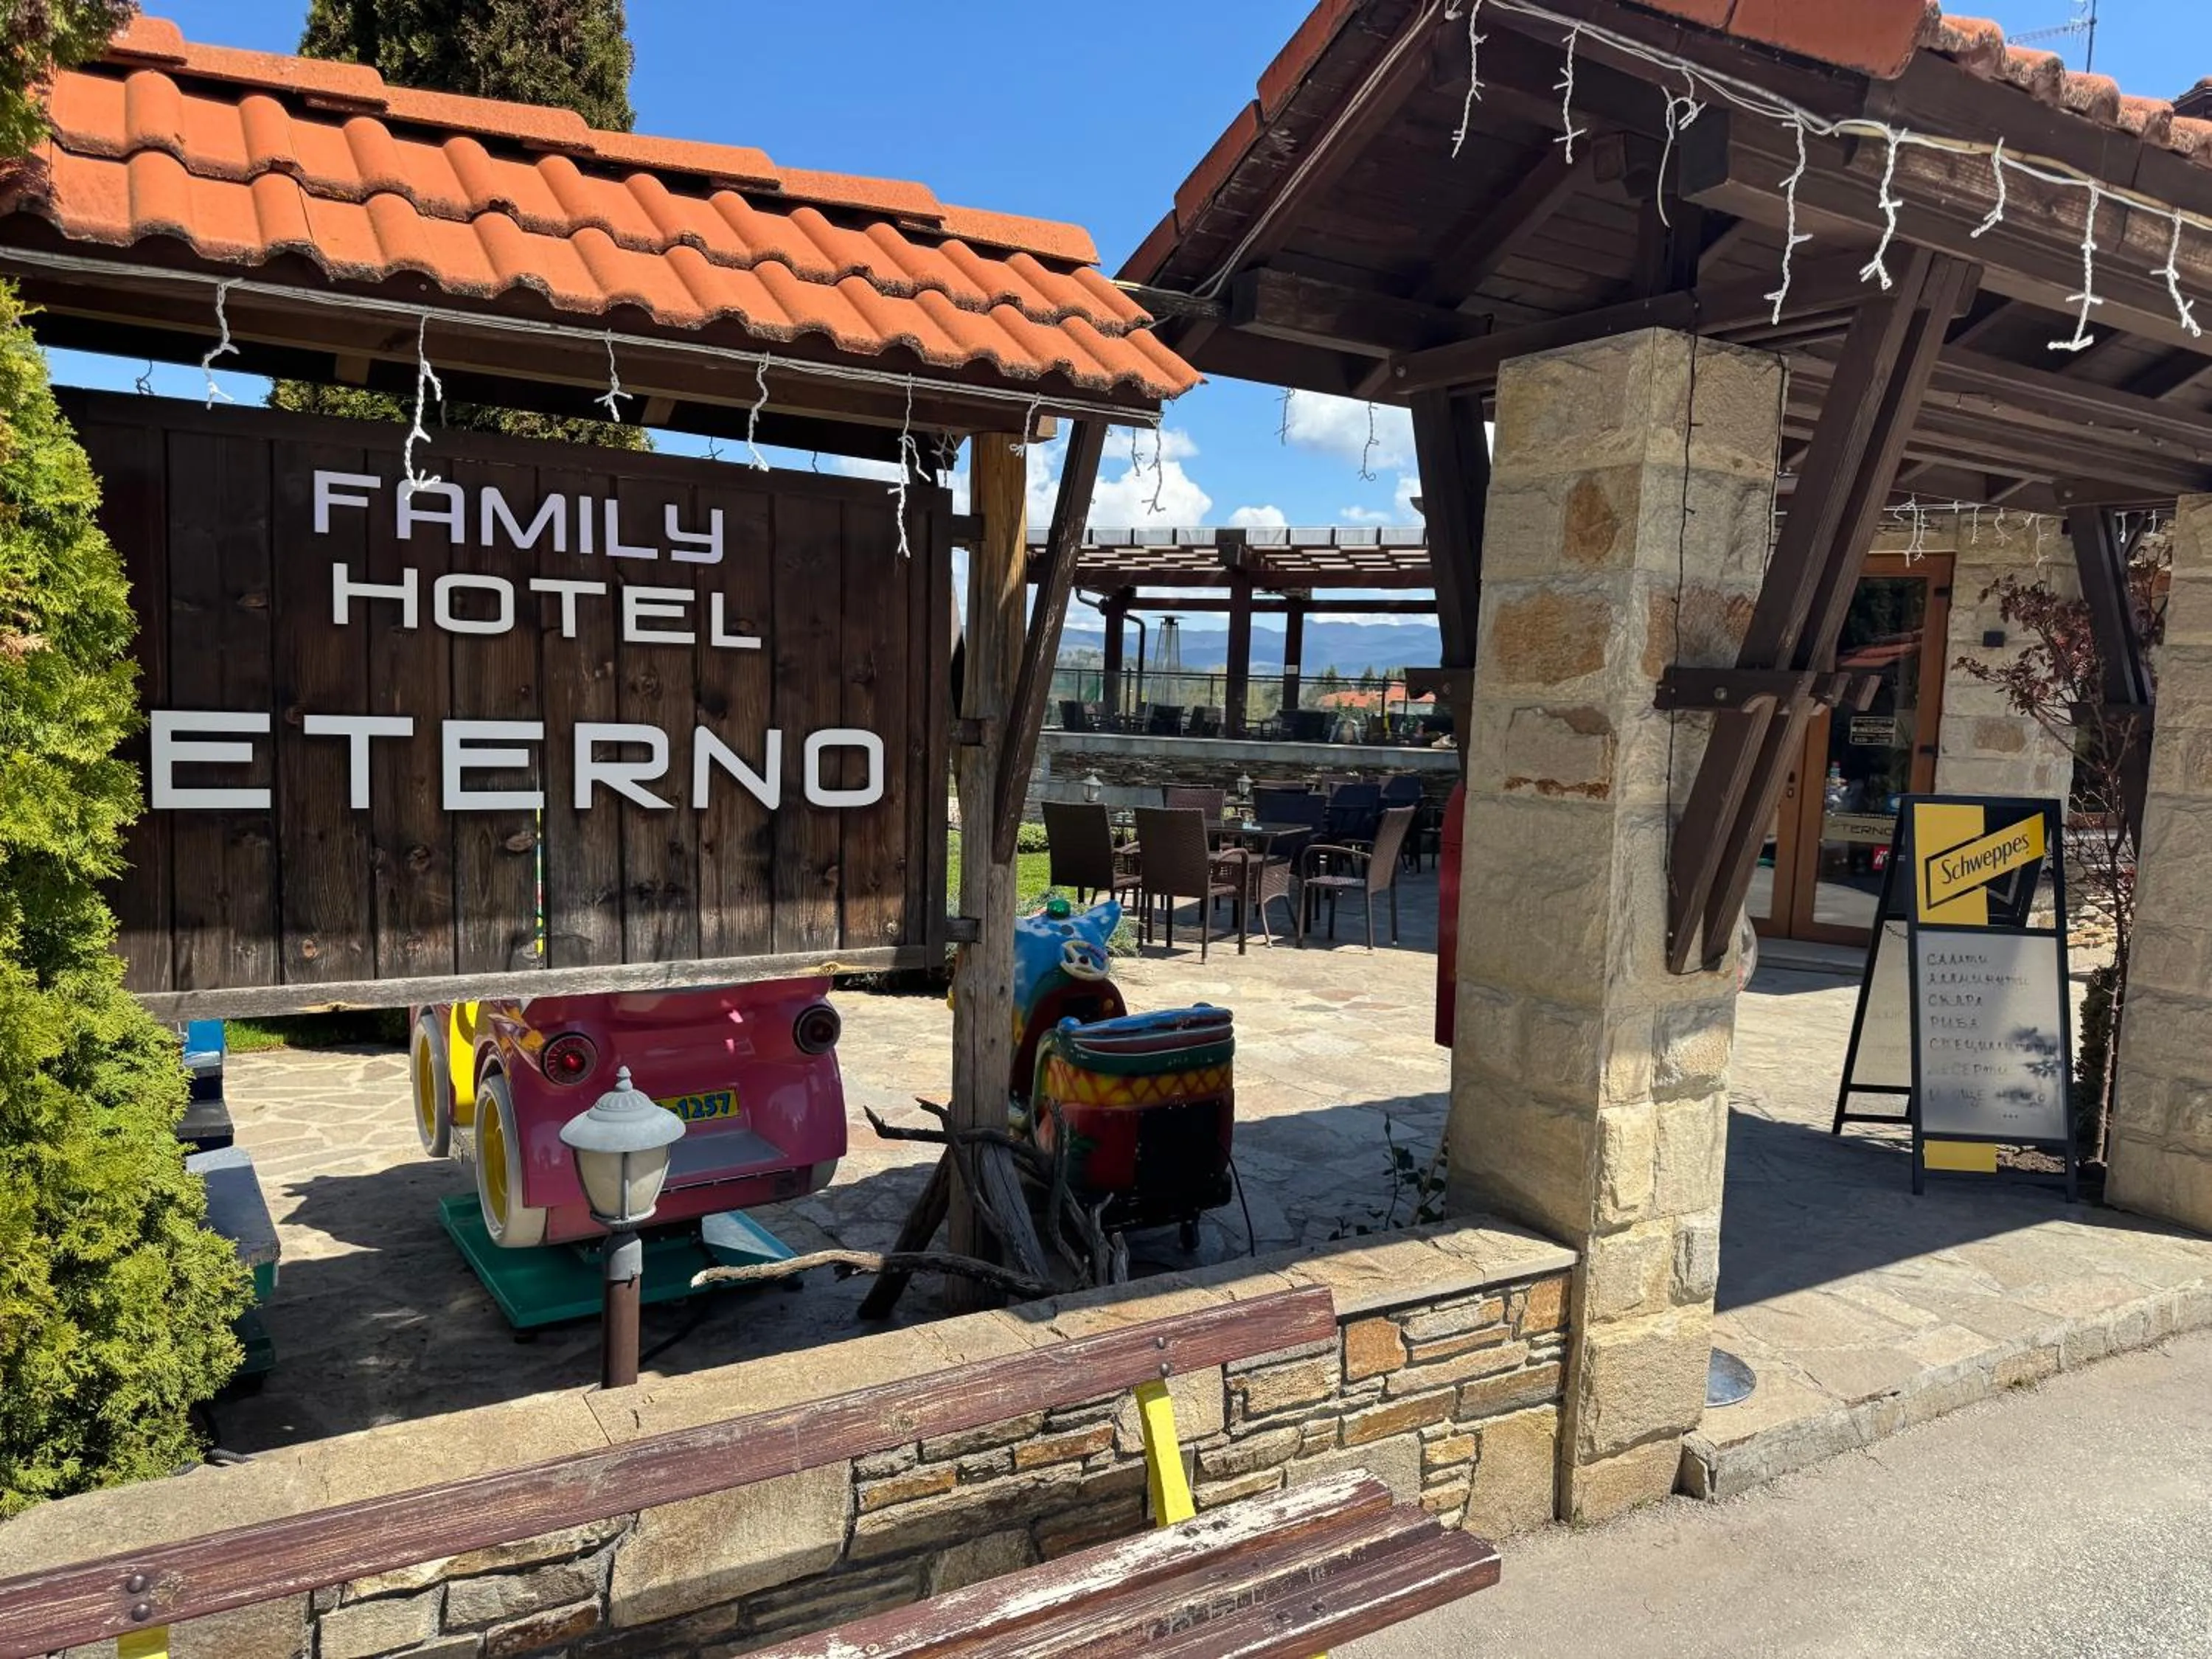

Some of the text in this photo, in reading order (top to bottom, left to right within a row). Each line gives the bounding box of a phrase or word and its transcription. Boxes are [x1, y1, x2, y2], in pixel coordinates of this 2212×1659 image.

[313, 469, 723, 564] FAMILY
[332, 562, 762, 650] HOTEL
[150, 710, 885, 810] ETERNO
[1941, 834, 2030, 884] Schweppes
